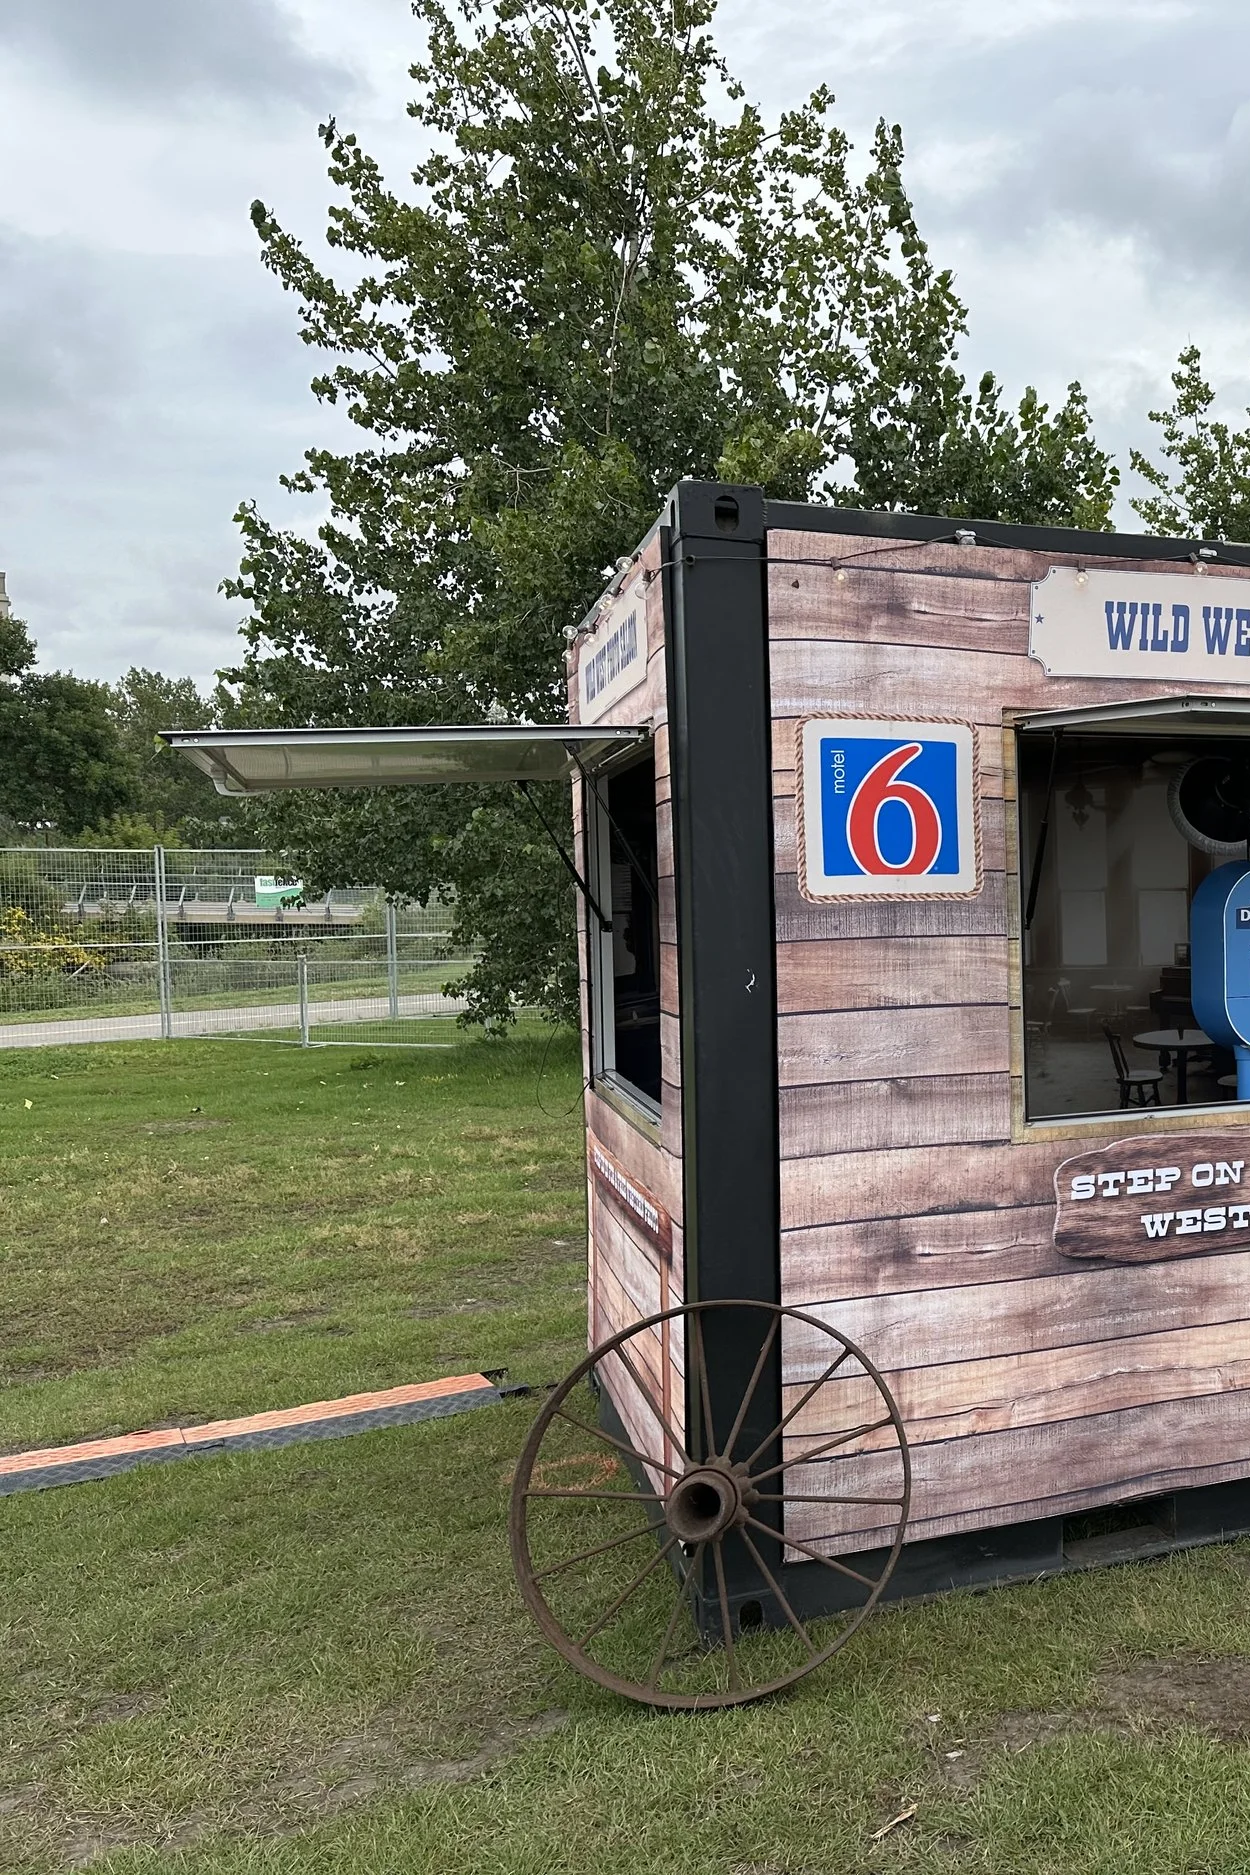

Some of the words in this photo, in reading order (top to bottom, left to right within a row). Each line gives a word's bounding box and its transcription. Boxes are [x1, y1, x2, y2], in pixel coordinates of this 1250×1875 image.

[1104, 600, 1190, 653] WILD
[830, 749, 846, 794] motel
[846, 742, 943, 876] 6
[1071, 1166, 1181, 1200] STEP
[1191, 1160, 1245, 1188] ON
